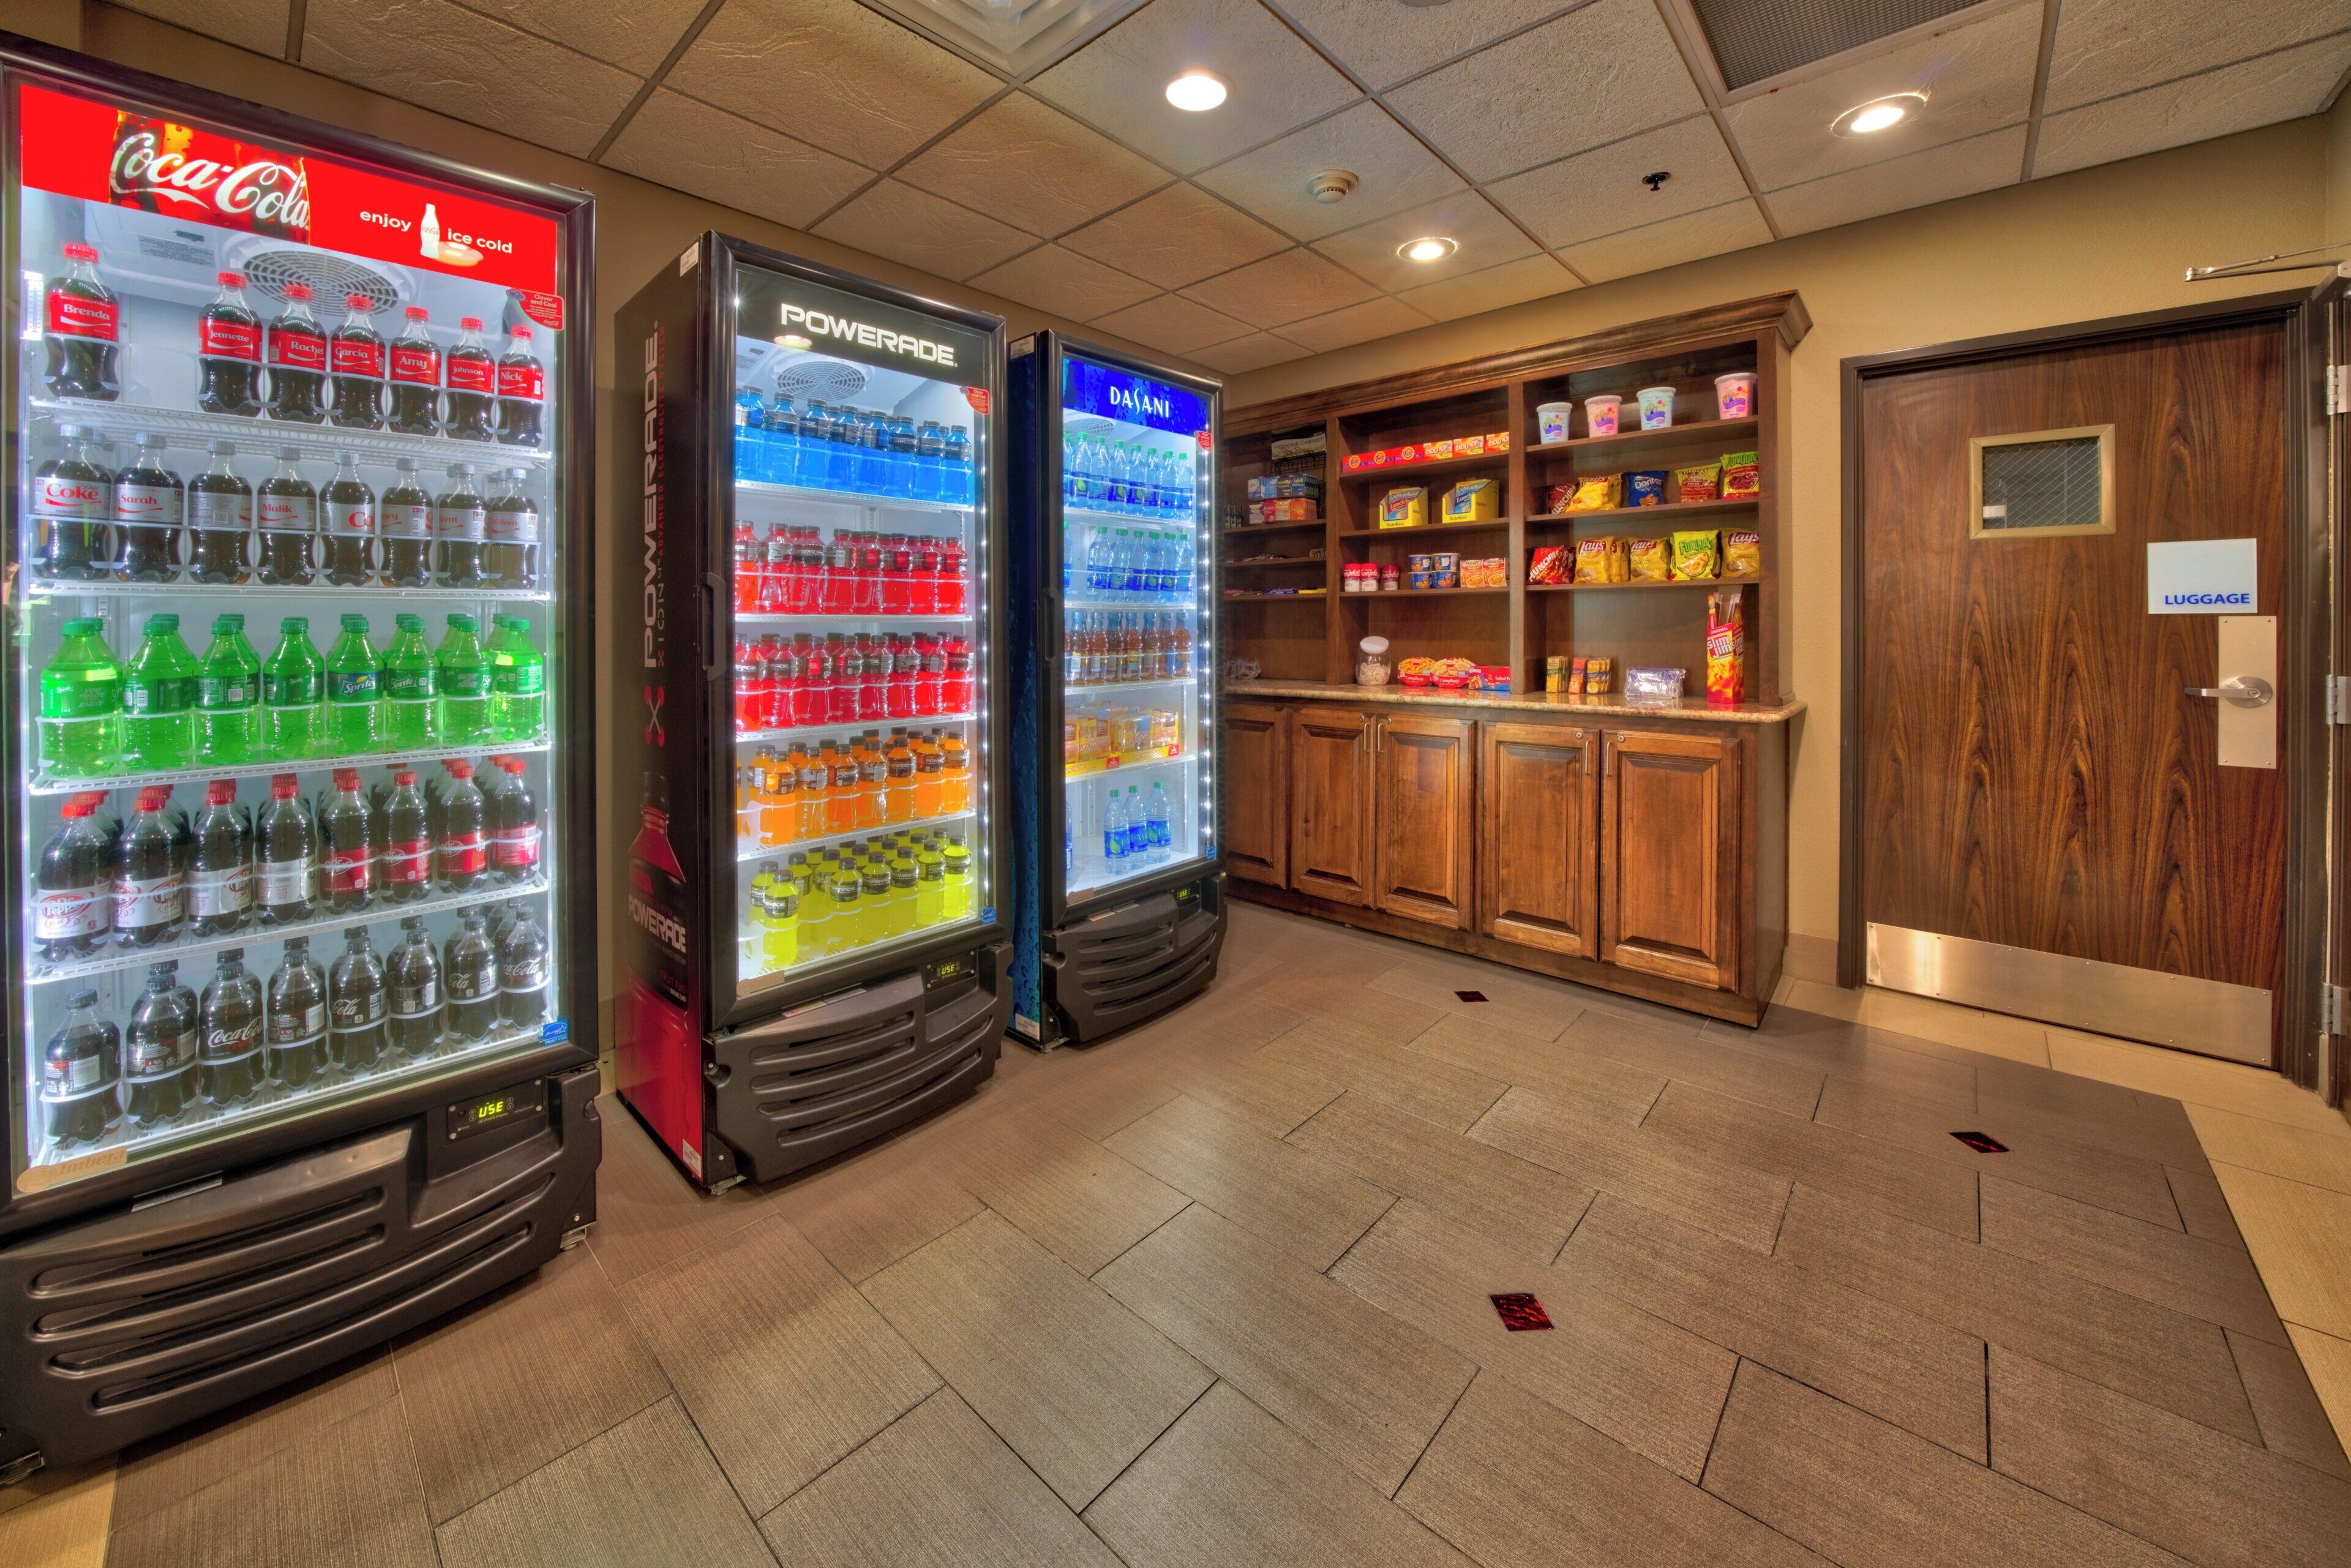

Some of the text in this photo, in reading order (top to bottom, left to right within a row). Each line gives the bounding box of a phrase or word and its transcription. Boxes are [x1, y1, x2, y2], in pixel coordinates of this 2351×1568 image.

[110, 133, 310, 228] Coca-Cola
[360, 211, 411, 232] enjoy
[448, 228, 513, 254] ice cold
[64, 304, 110, 320] Brenda
[210, 329, 250, 342] Jeanette
[781, 303, 954, 367] POWERADE
[291, 341, 324, 355] Rachel
[336, 347, 368, 358] Garcia
[399, 356, 427, 370] Amy
[453, 366, 484, 377] Johnson
[501, 372, 523, 382] Nick
[1110, 386, 1169, 418] DASANI
[1273, 437, 1323, 450] MEDICINE CABINET
[1455, 440, 1479, 452] bounce
[1425, 445, 1449, 456] bounce
[1374, 454, 1384, 463] Tide
[1634, 478, 1662, 490] Doritos
[47, 483, 99, 500] Coke
[121, 494, 158, 505] Sarah
[644, 331, 659, 668] POWERADE
[263, 504, 293, 513] Malik
[1580, 541, 1605, 554] Lay's
[2165, 593, 2250, 605] LUGGAGE
[1710, 626, 1728, 635] ORIGINAL
[343, 679, 375, 694] Sprite
[392, 677, 415, 689] Sprite
[628, 895, 686, 953] POWERADE
[942, 964, 954, 974] USE
[479, 1101, 503, 1118] USE
